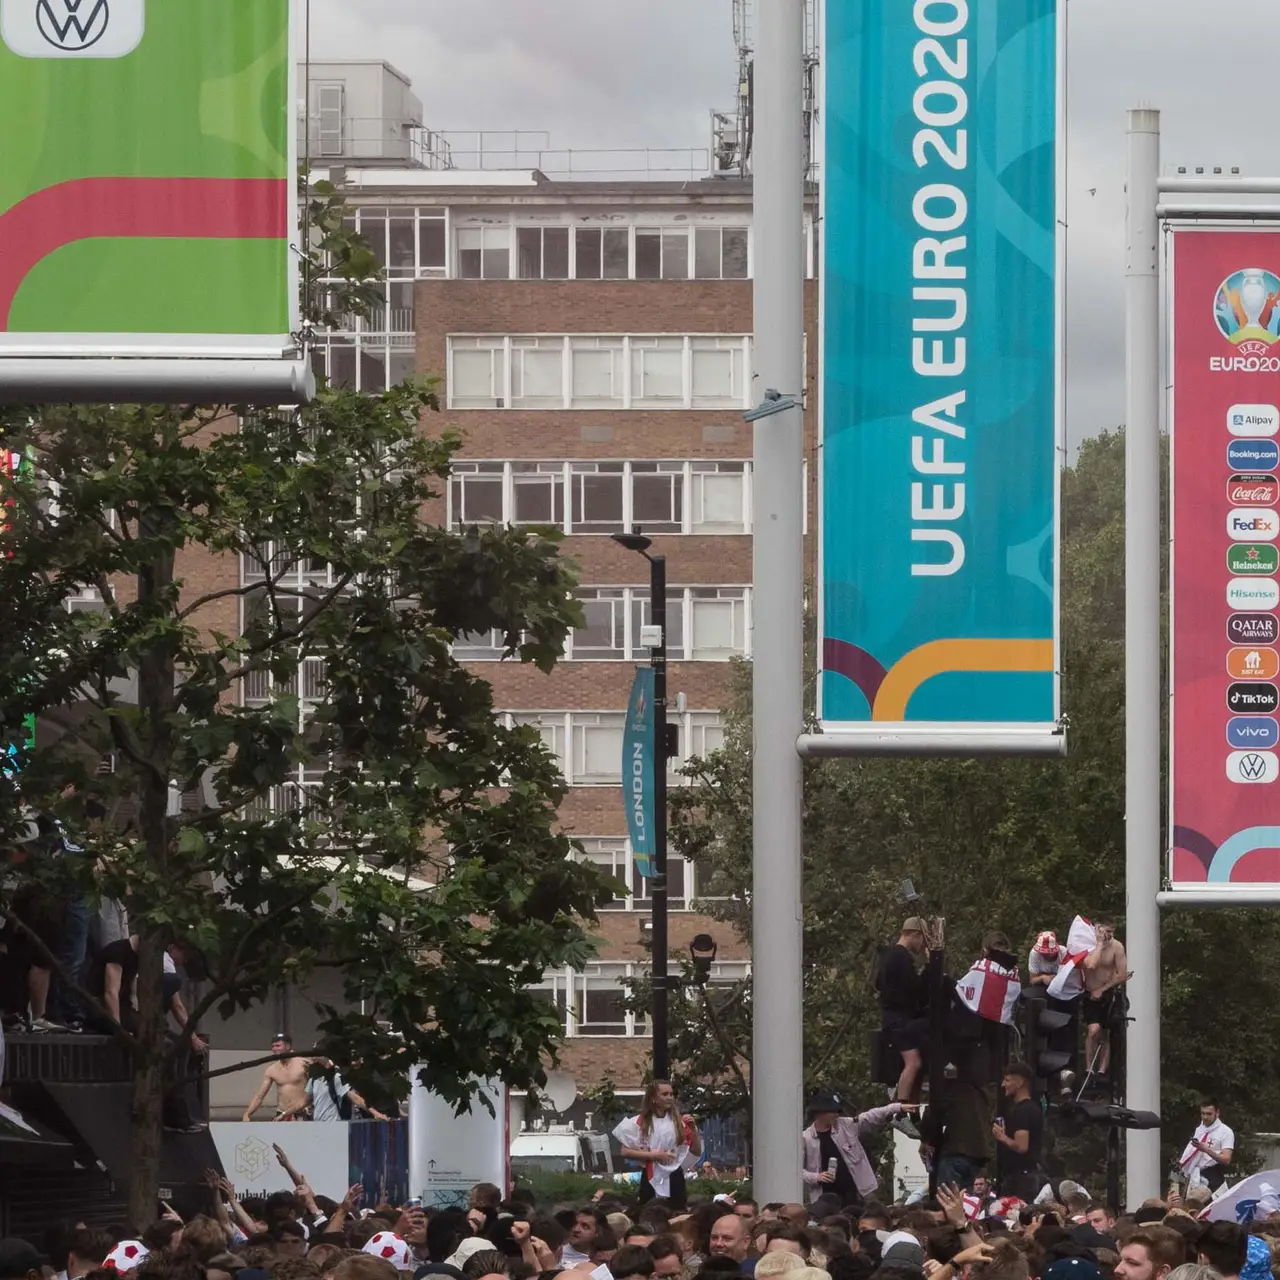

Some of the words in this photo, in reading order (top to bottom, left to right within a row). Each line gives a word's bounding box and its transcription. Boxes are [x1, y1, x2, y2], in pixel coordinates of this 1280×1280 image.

[912, 0, 968, 170] 2020
[911, 183, 968, 377] EURO
[1237, 341, 1269, 355] UEFA
[1245, 415, 1273, 425] Alipay
[1229, 450, 1277, 460] Booking.com
[911, 390, 967, 577] UEFA
[1233, 518, 1272, 531] FedEx
[1232, 560, 1273, 570] Heineken
[1230, 589, 1275, 598] Hisense
[1232, 620, 1273, 633] QATAR
[1242, 630, 1273, 638] AIRWAYS
[1242, 694, 1274, 704] TikTok
[1236, 727, 1269, 737] vivo
[633, 743, 644, 841] LONDON
